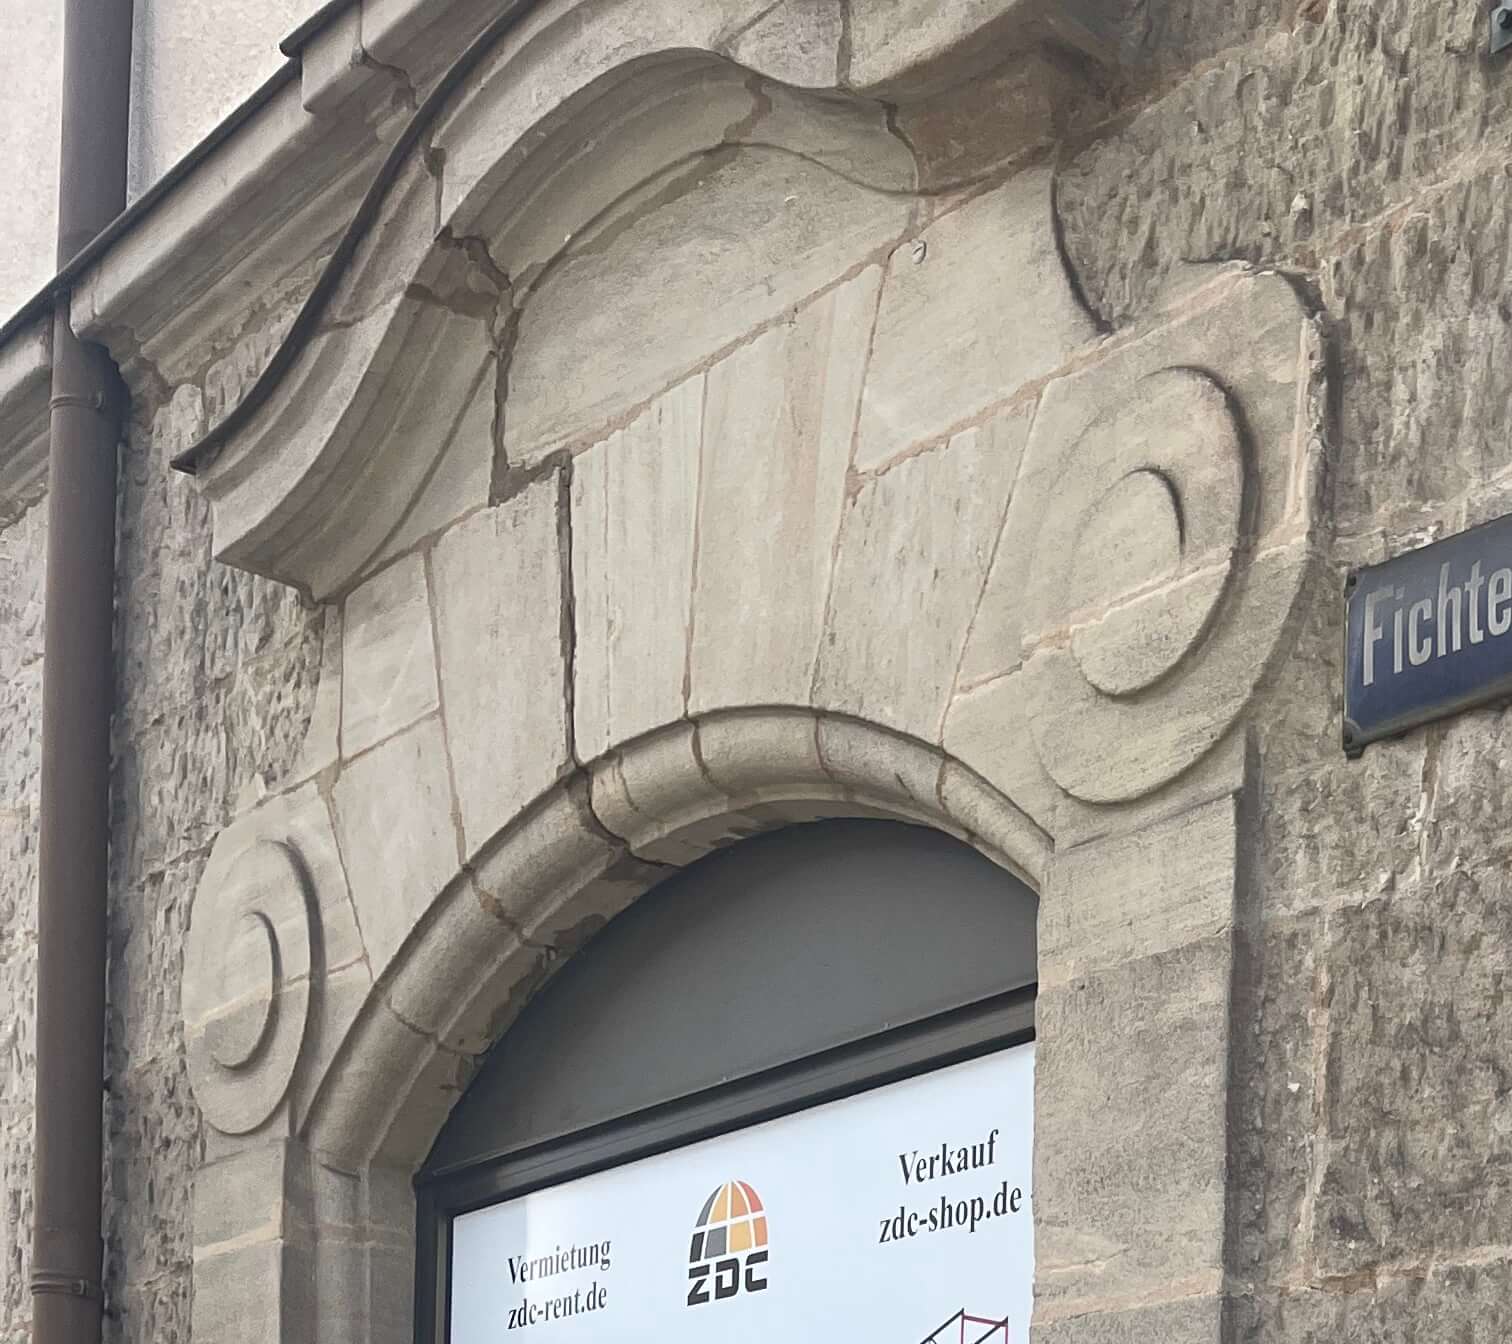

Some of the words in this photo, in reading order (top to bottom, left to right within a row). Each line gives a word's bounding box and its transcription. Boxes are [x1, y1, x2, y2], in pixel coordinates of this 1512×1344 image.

[899, 1128, 999, 1185] Verkauf
[879, 1181, 1022, 1243] zdc-shop.de
[508, 1240, 611, 1285] Vermietung
[687, 1250, 768, 1305] ZDC
[507, 1281, 607, 1330] zdc-rent.de
